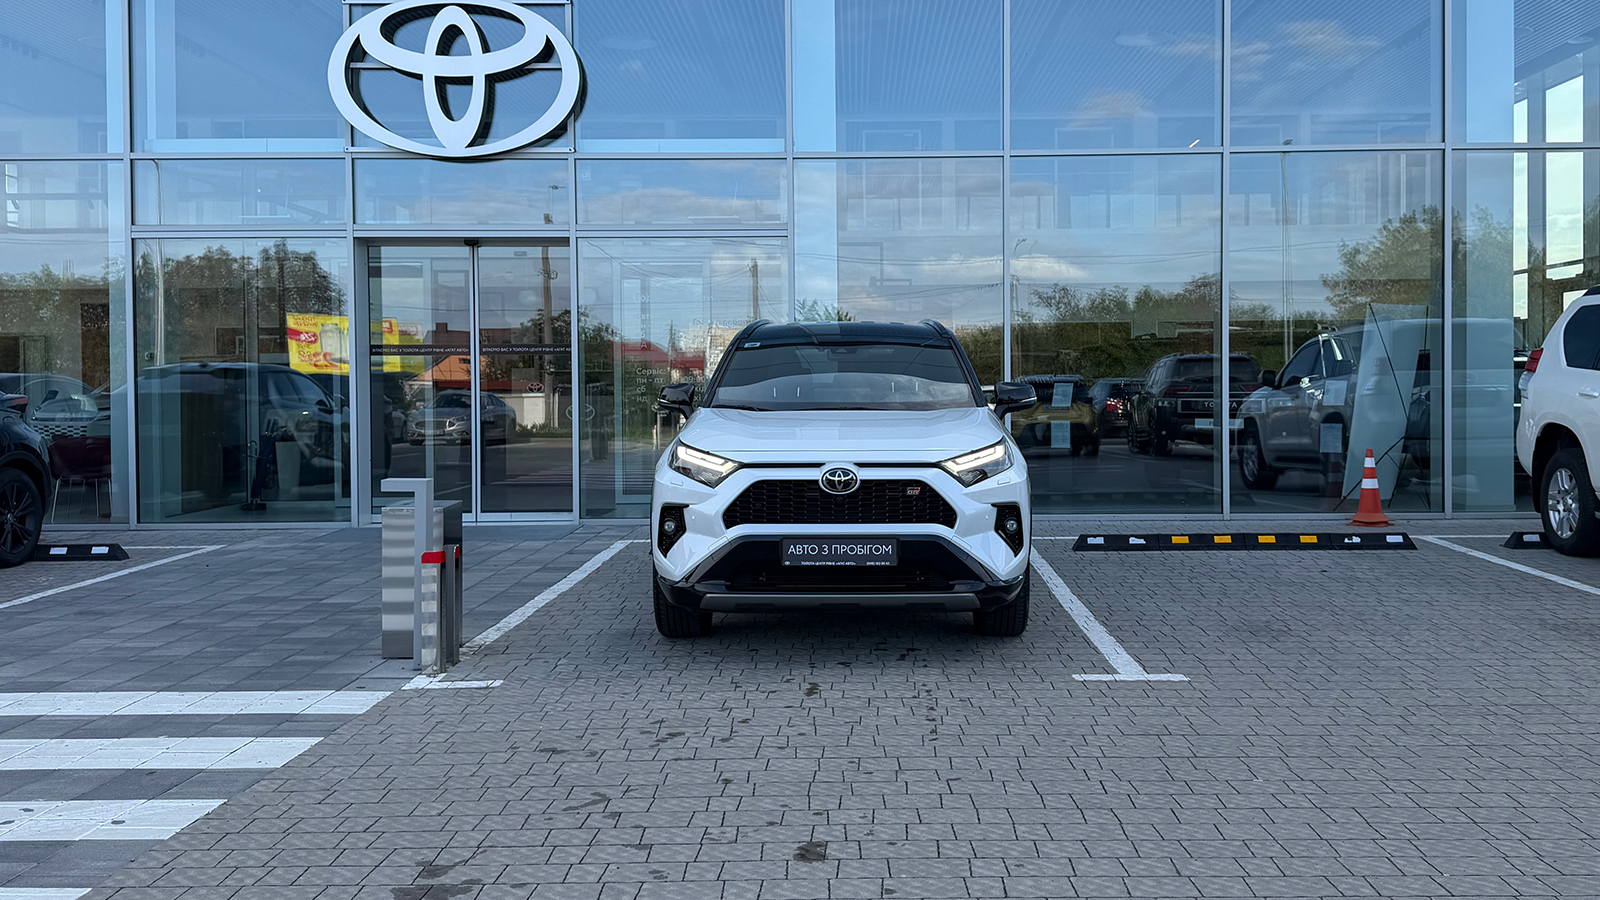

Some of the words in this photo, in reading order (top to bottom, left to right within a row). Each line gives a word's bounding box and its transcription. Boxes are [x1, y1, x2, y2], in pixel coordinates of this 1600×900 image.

[636, 367, 666, 376] Сервіс:
[788, 545, 819, 555] АВТО
[832, 545, 892, 555] ПРОБІГОМ
